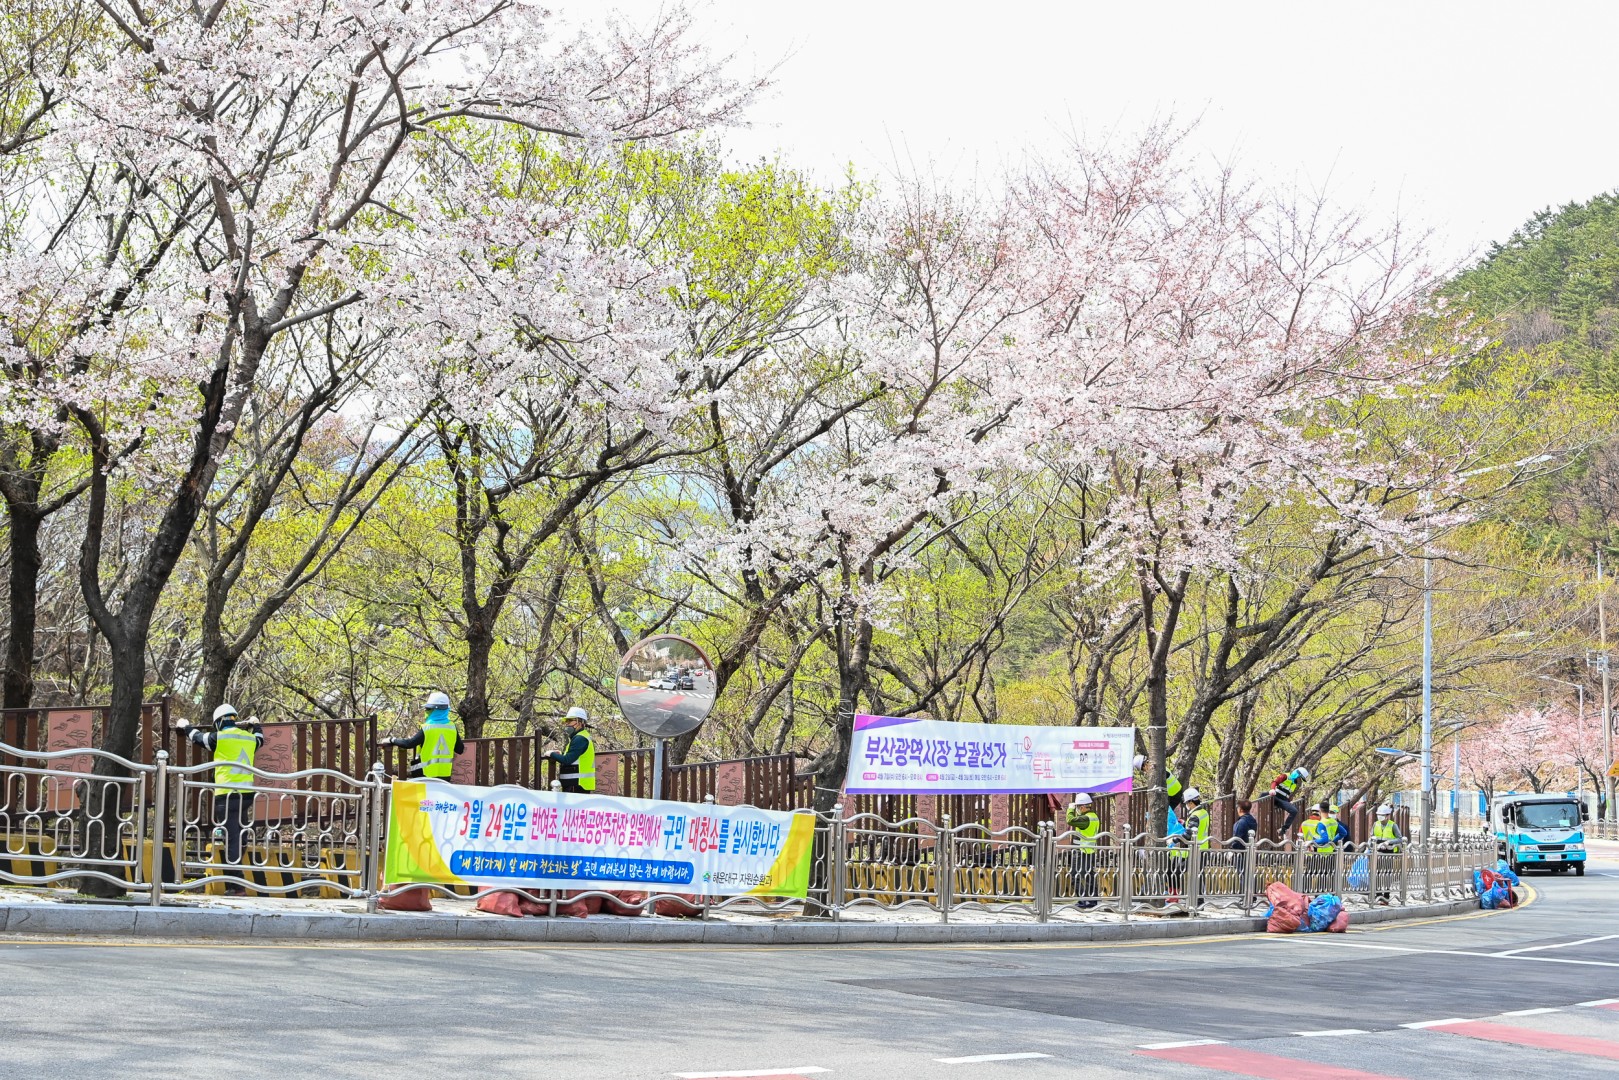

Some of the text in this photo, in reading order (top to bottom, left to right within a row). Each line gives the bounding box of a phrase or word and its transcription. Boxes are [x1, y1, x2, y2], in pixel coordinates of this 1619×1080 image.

[865, 736, 1007, 768] 부산광역시장 보궐선거
[1033, 758, 1055, 781] 투표
[435, 801, 457, 813] 해운대
[460, 800, 483, 839] 3월
[485, 803, 527, 841] 24일은
[531, 807, 560, 843] 반여초,
[628, 814, 662, 847] 일원에서
[664, 815, 687, 850] 구민
[688, 817, 730, 853] 대청소를
[732, 820, 781, 856] 실시합니다.
[509, 857, 517, 873] 앞
[520, 859, 538, 872] 내가
[540, 859, 569, 875] 청소하는
[584, 861, 598, 876] 주민
[599, 862, 627, 877] 여러분의
[629, 863, 643, 878] 많은
[644, 863, 659, 878] 참여
[660, 865, 690, 880] 바랍니다.
[713, 872, 773, 886] 해운대구 자원순환과
